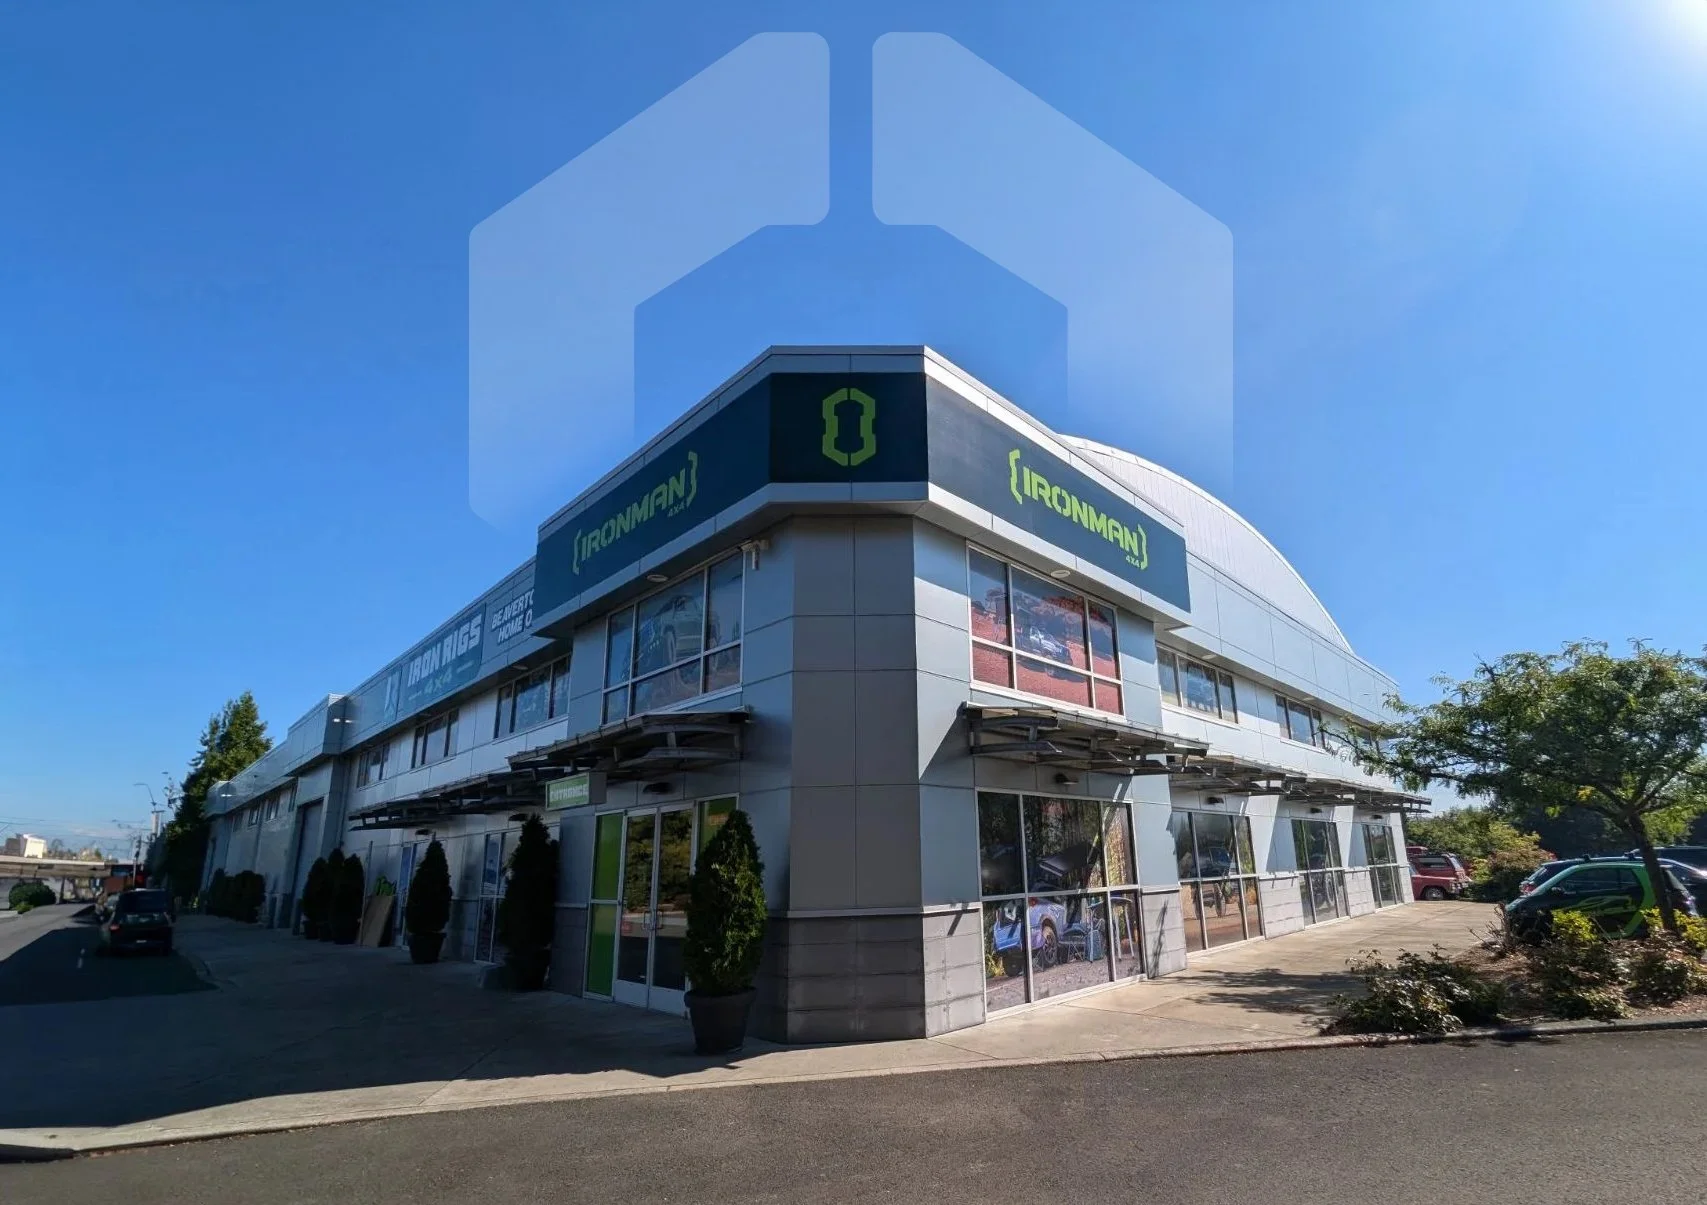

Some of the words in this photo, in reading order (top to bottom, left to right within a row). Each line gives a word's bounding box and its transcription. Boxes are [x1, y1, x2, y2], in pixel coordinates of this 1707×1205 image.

[581, 468, 686, 561] IRONMAN
[1023, 466, 1139, 556] IRONMAN
[407, 641, 442, 687] IRON
[442, 613, 482, 667] RIGS
[498, 615, 524, 643] HOME
